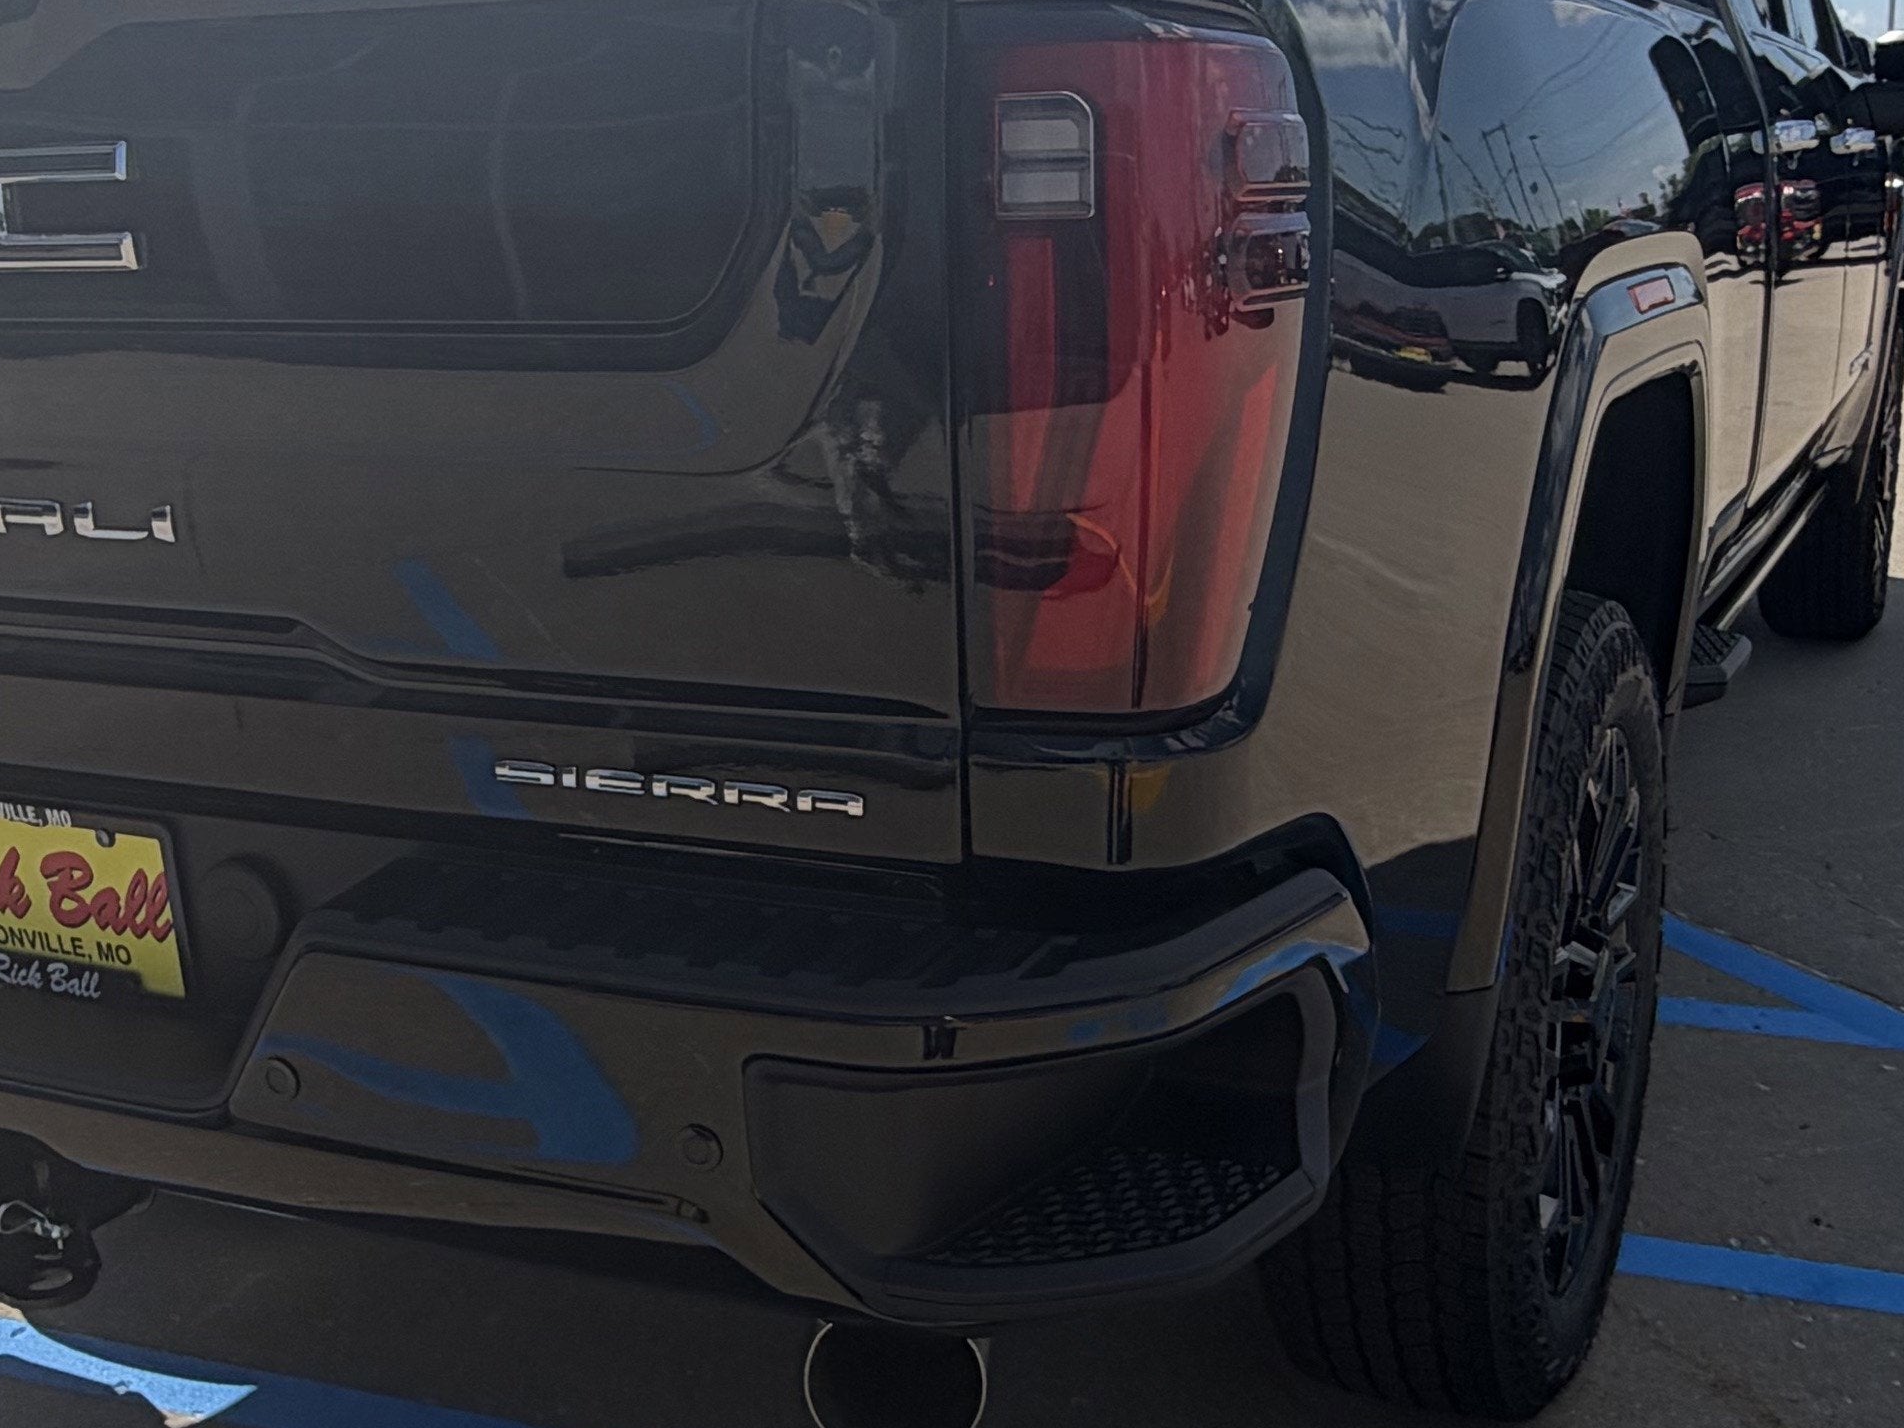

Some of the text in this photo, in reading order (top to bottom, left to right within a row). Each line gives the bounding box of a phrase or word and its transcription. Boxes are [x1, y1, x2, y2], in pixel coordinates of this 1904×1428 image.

[495, 759, 864, 817] SIERRA
[45, 808, 72, 827] MO
[40, 850, 173, 943] Ball
[97, 942, 132, 965] MO
[46, 962, 101, 999] Ball
